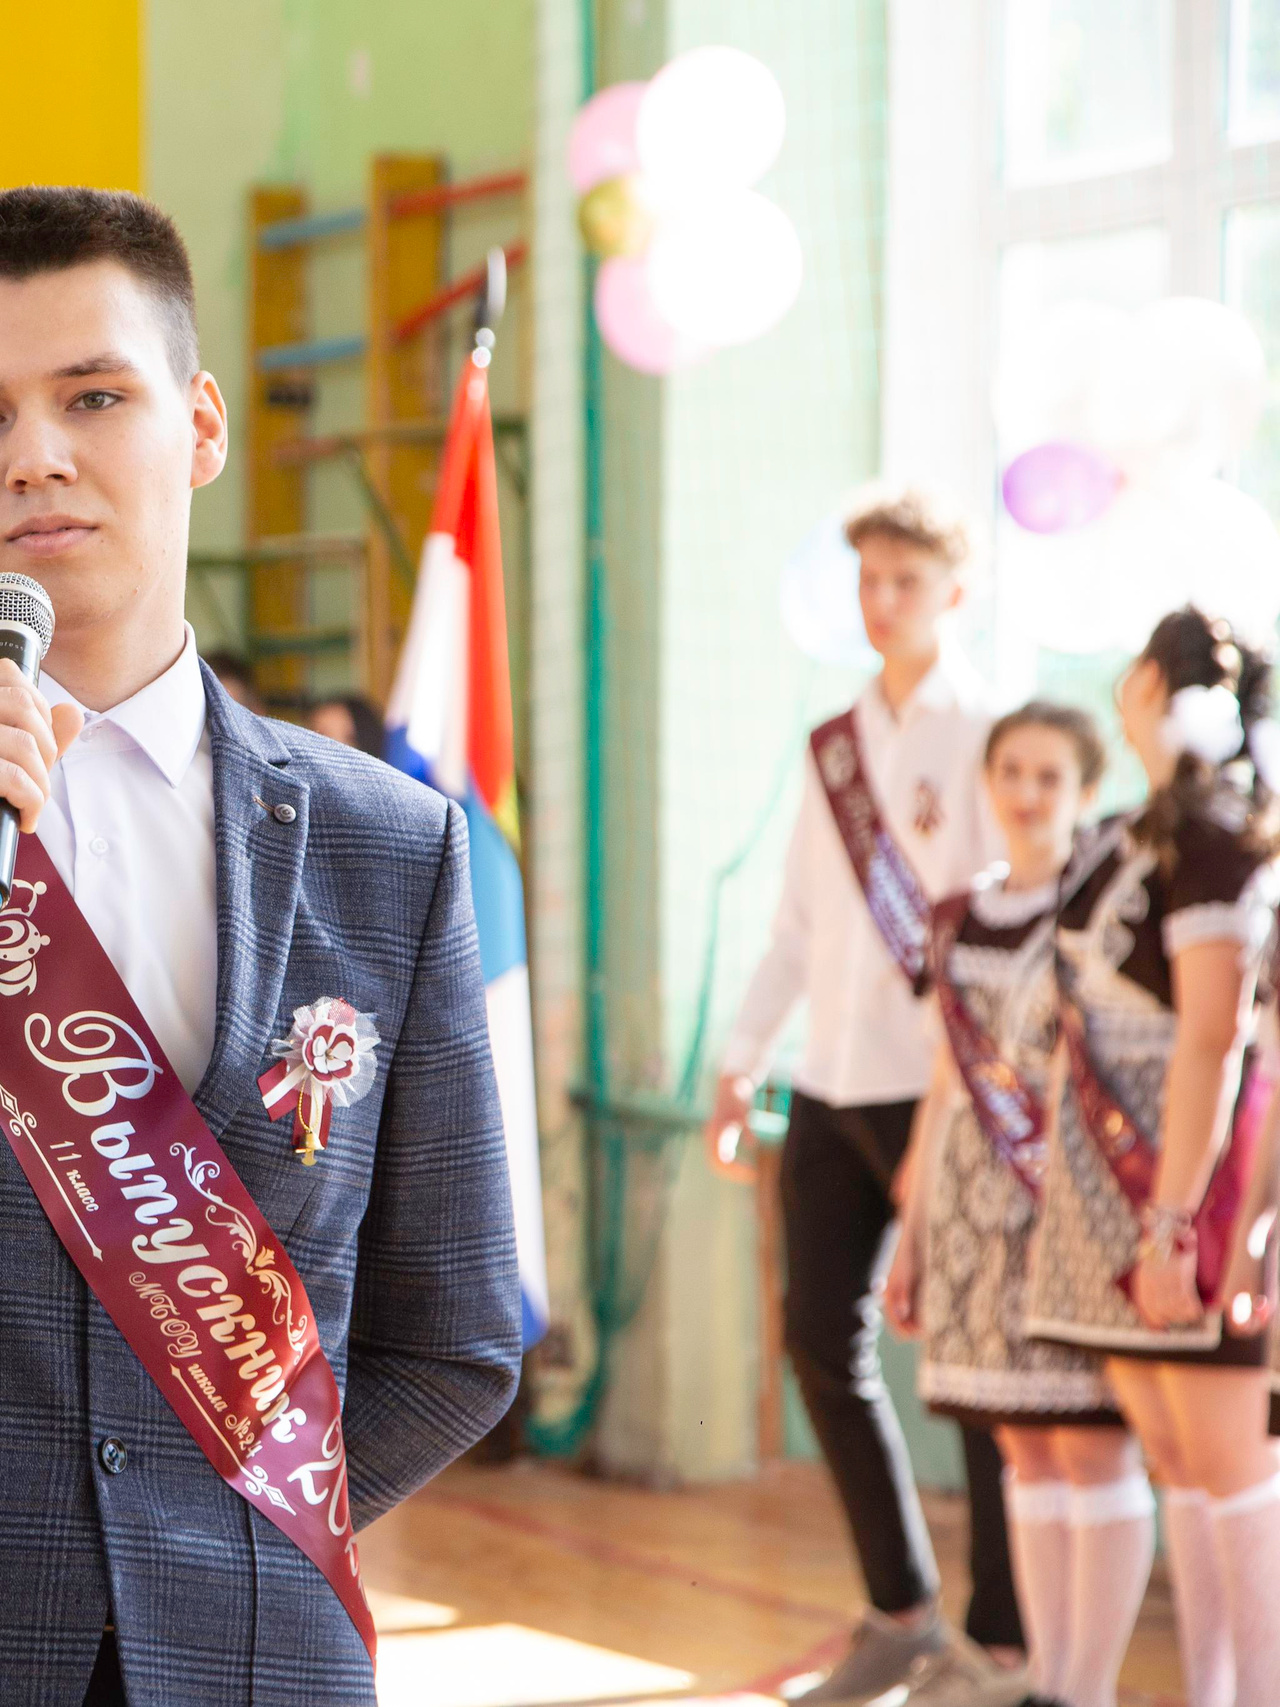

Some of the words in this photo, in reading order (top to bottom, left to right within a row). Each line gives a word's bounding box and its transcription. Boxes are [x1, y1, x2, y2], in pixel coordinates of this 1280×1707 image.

[24, 1010, 308, 1444] Выпускник
[50, 1140, 82, 1162] 11
[66, 1169, 99, 1212] класс
[128, 1271, 203, 1359] МБОУ
[187, 1362, 228, 1413] школа
